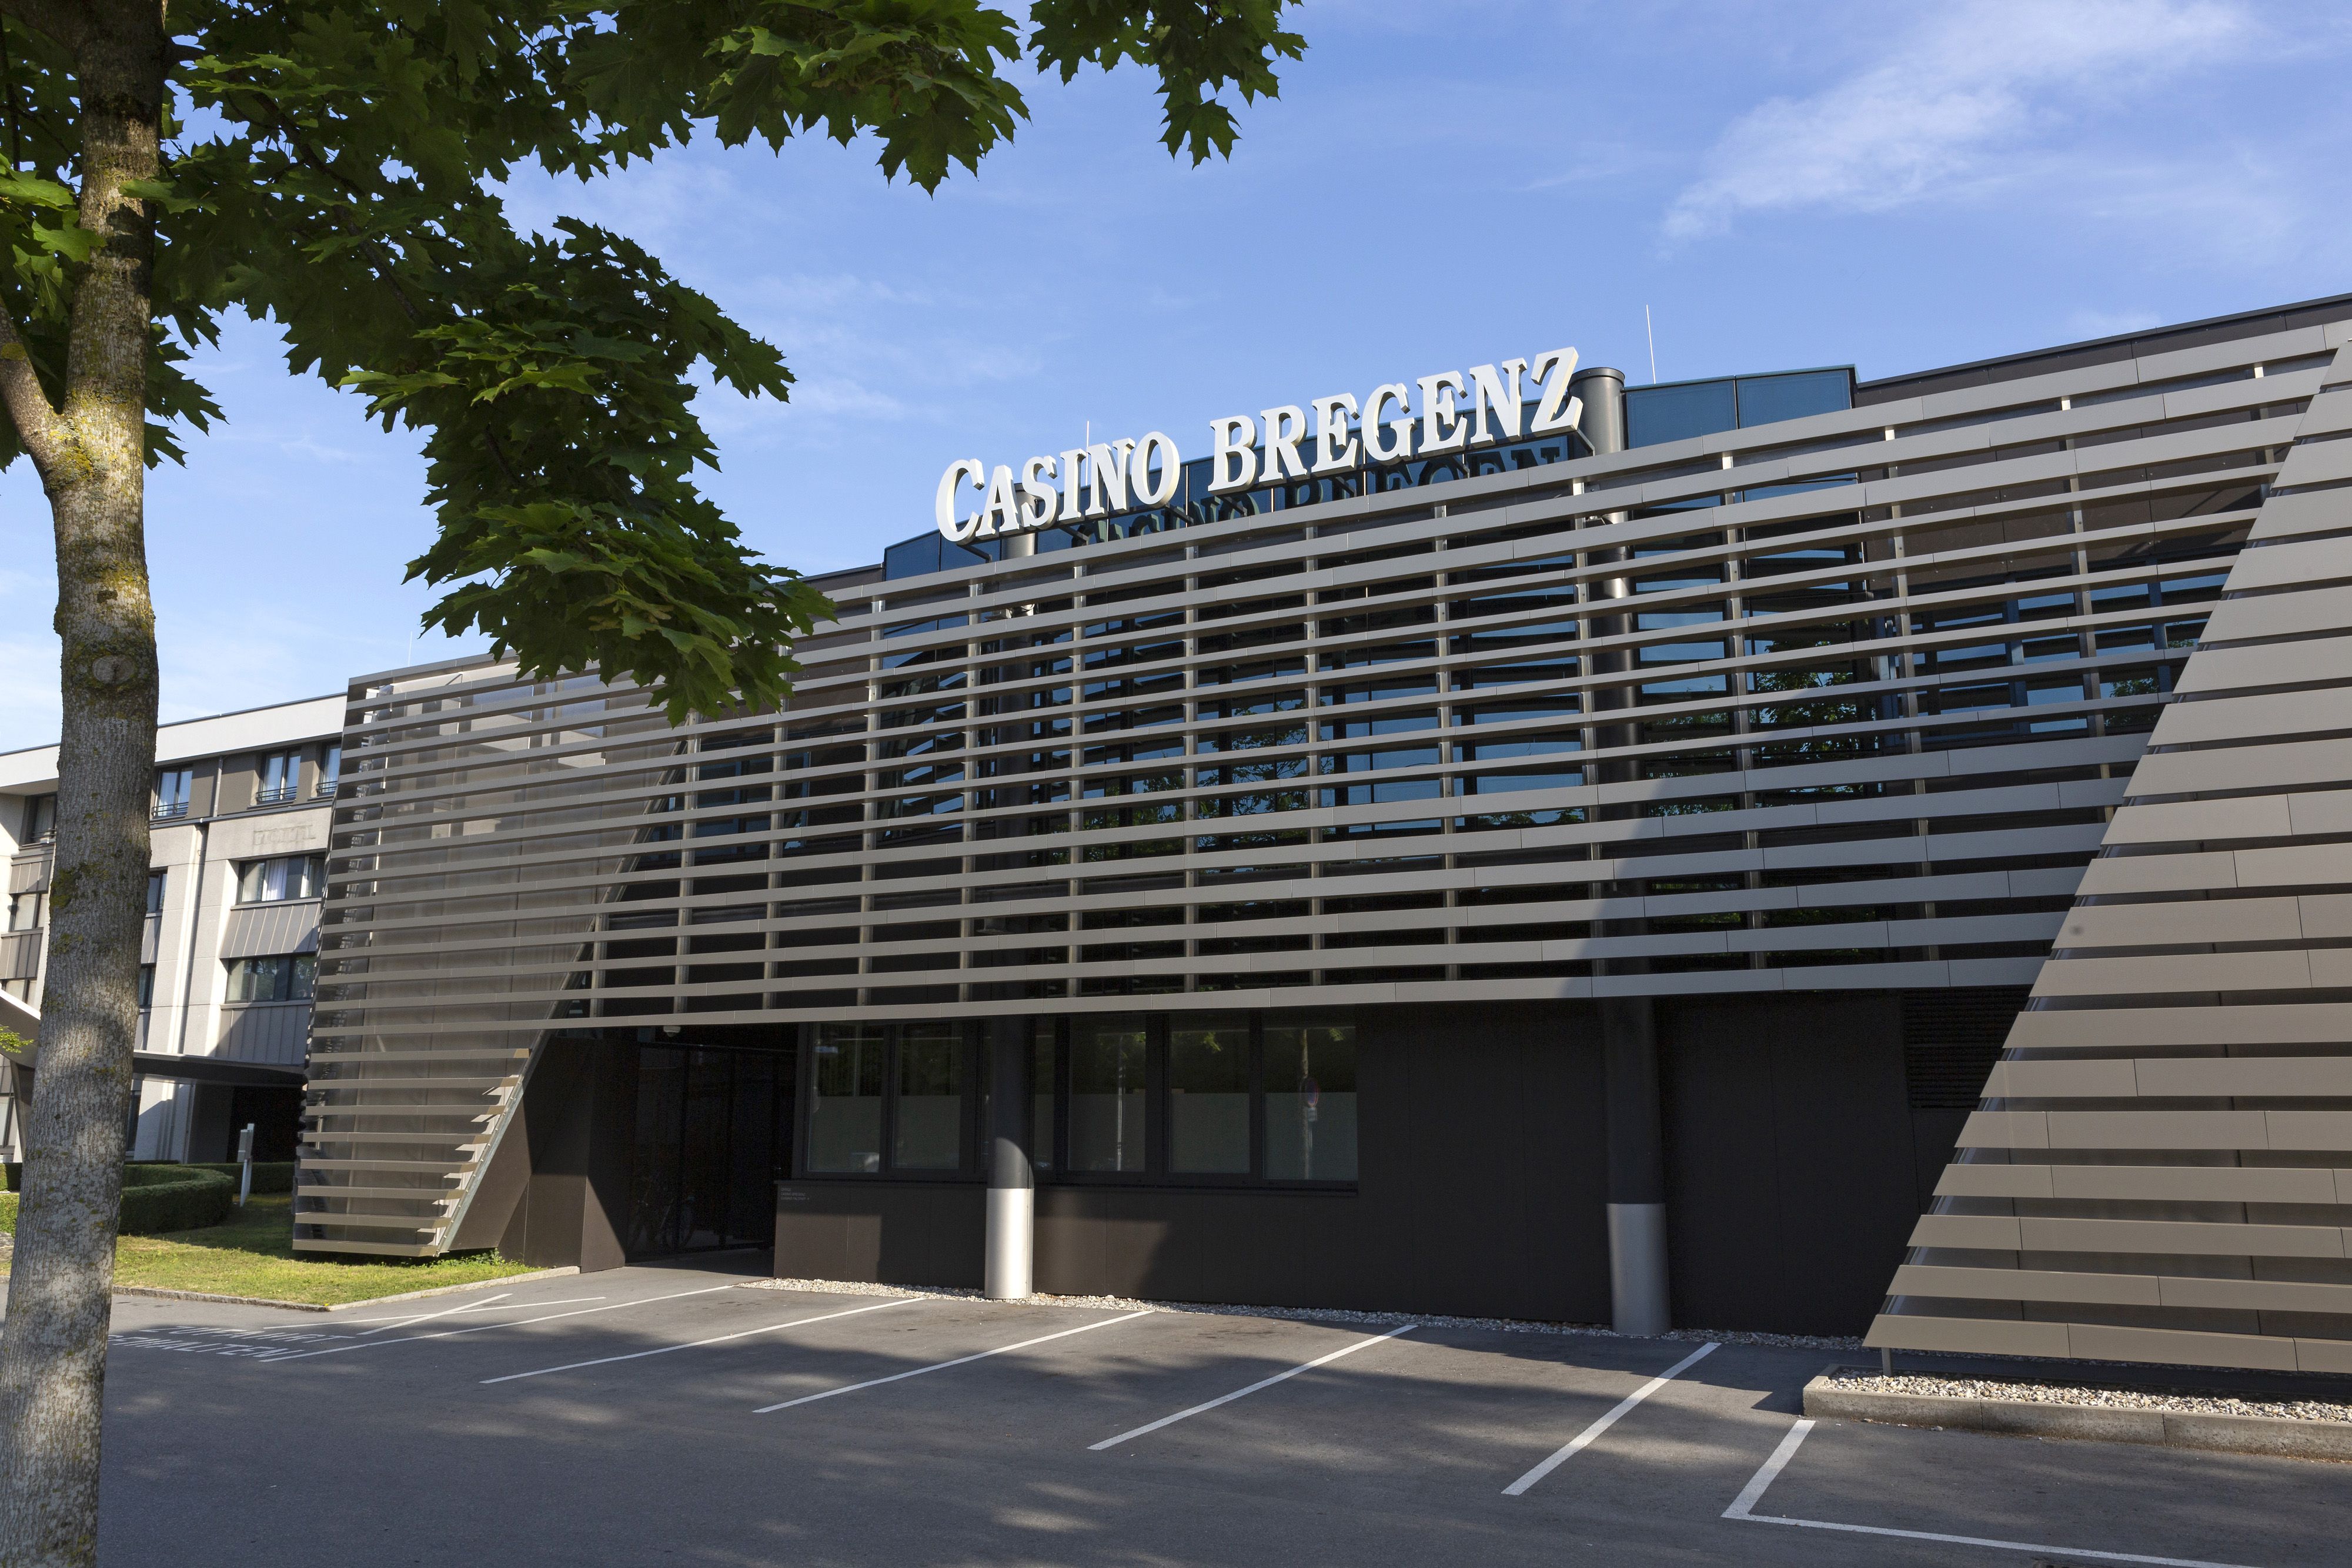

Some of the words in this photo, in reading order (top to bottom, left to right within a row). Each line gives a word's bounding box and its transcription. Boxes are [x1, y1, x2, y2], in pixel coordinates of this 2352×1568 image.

[935, 430, 1180, 546] CASINO
[1208, 346, 1583, 496] BREGENZ
[139, 1326, 356, 1343] ZUFAHRT
